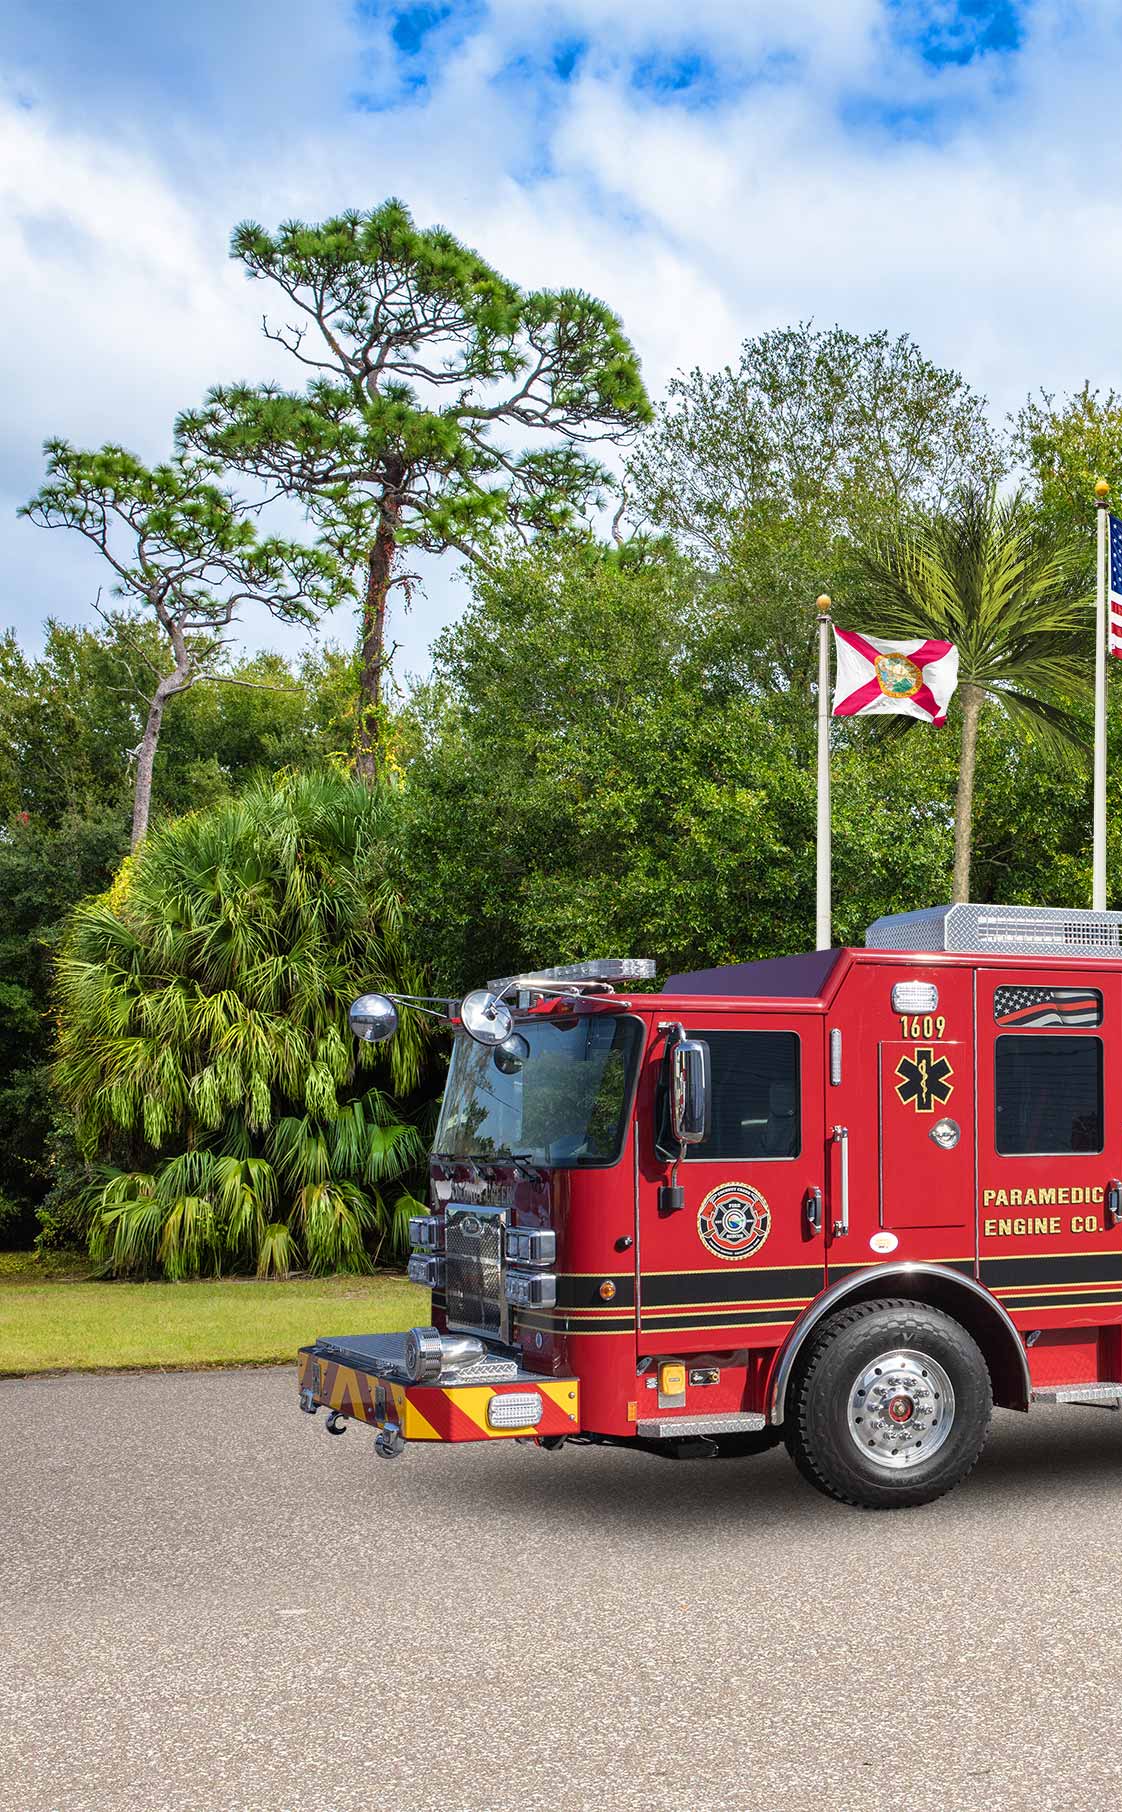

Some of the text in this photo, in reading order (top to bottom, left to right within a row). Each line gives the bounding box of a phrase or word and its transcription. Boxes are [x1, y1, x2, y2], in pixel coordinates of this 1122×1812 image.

[900, 1015, 946, 1039] 1609
[983, 1186, 1104, 1208] PARAMEDIC
[984, 1215, 1104, 1236] ENGINE CO.
